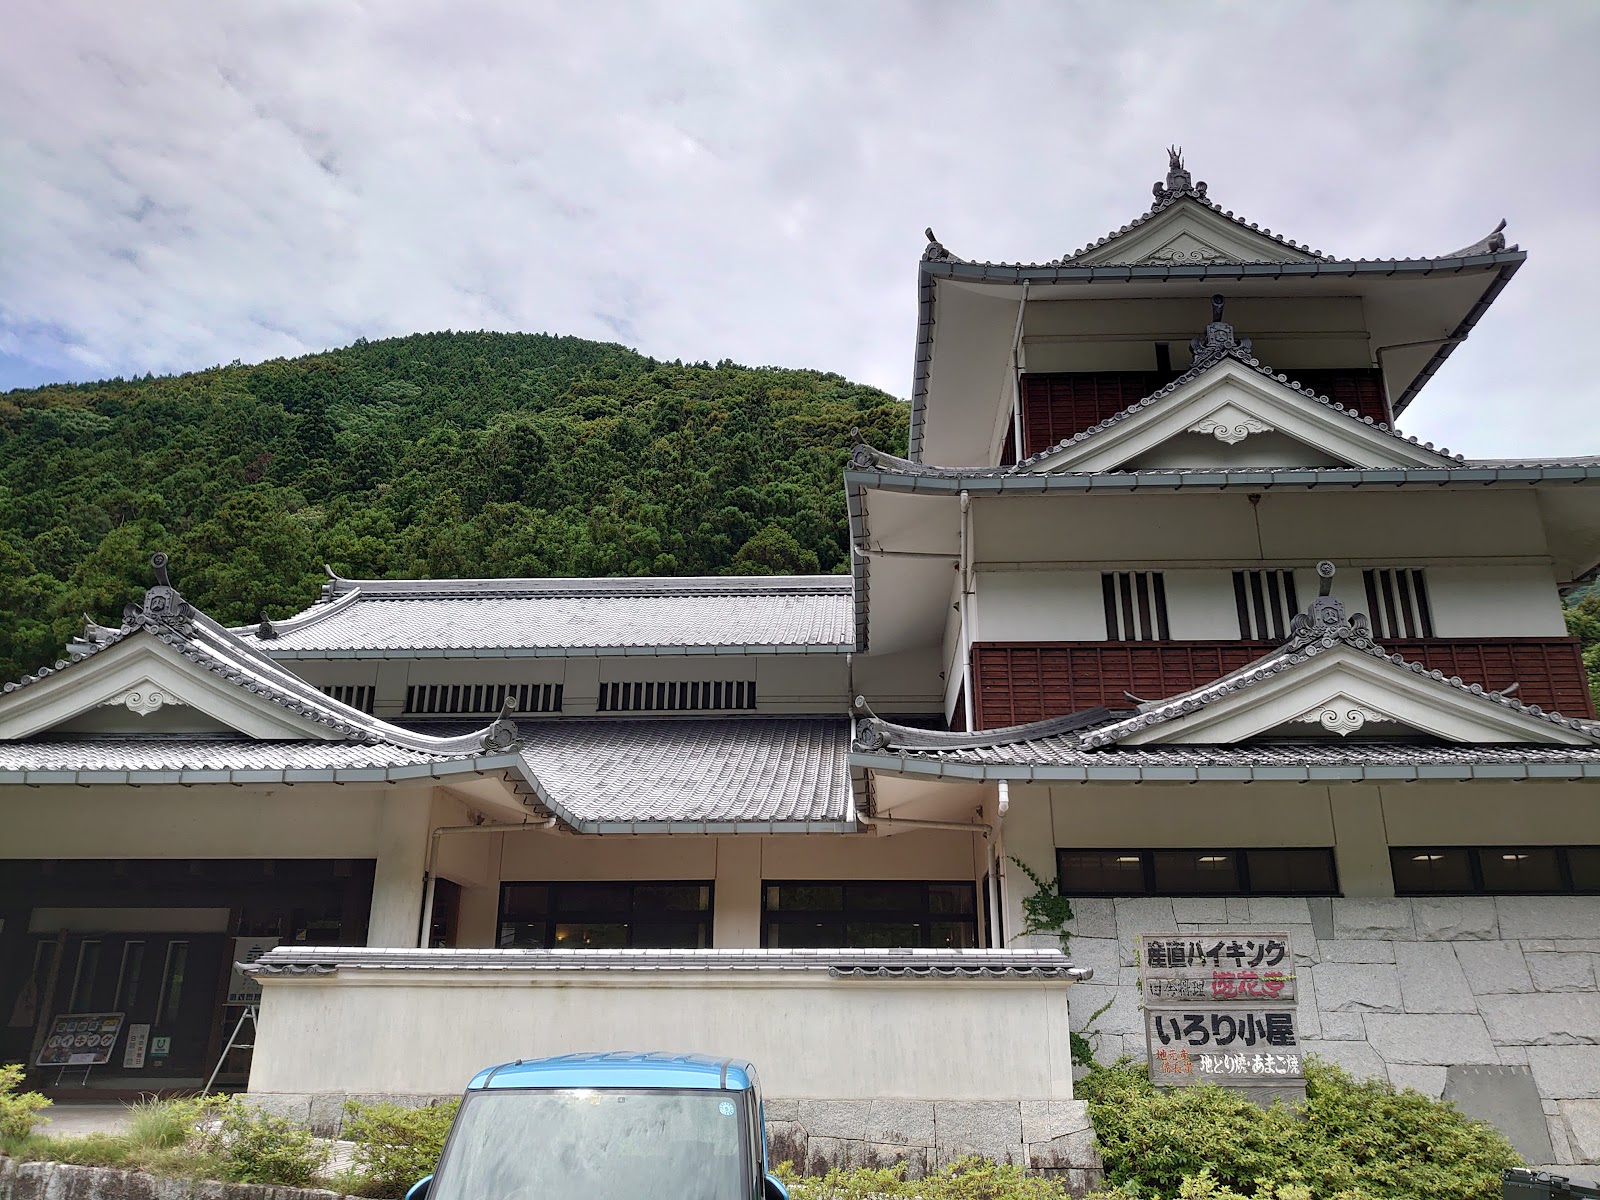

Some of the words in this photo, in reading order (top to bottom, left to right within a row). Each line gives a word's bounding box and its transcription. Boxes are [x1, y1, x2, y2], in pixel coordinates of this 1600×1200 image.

[1147, 940, 1286, 968] 産直バイキング
[1155, 1013, 1297, 1046] いろり小屋
